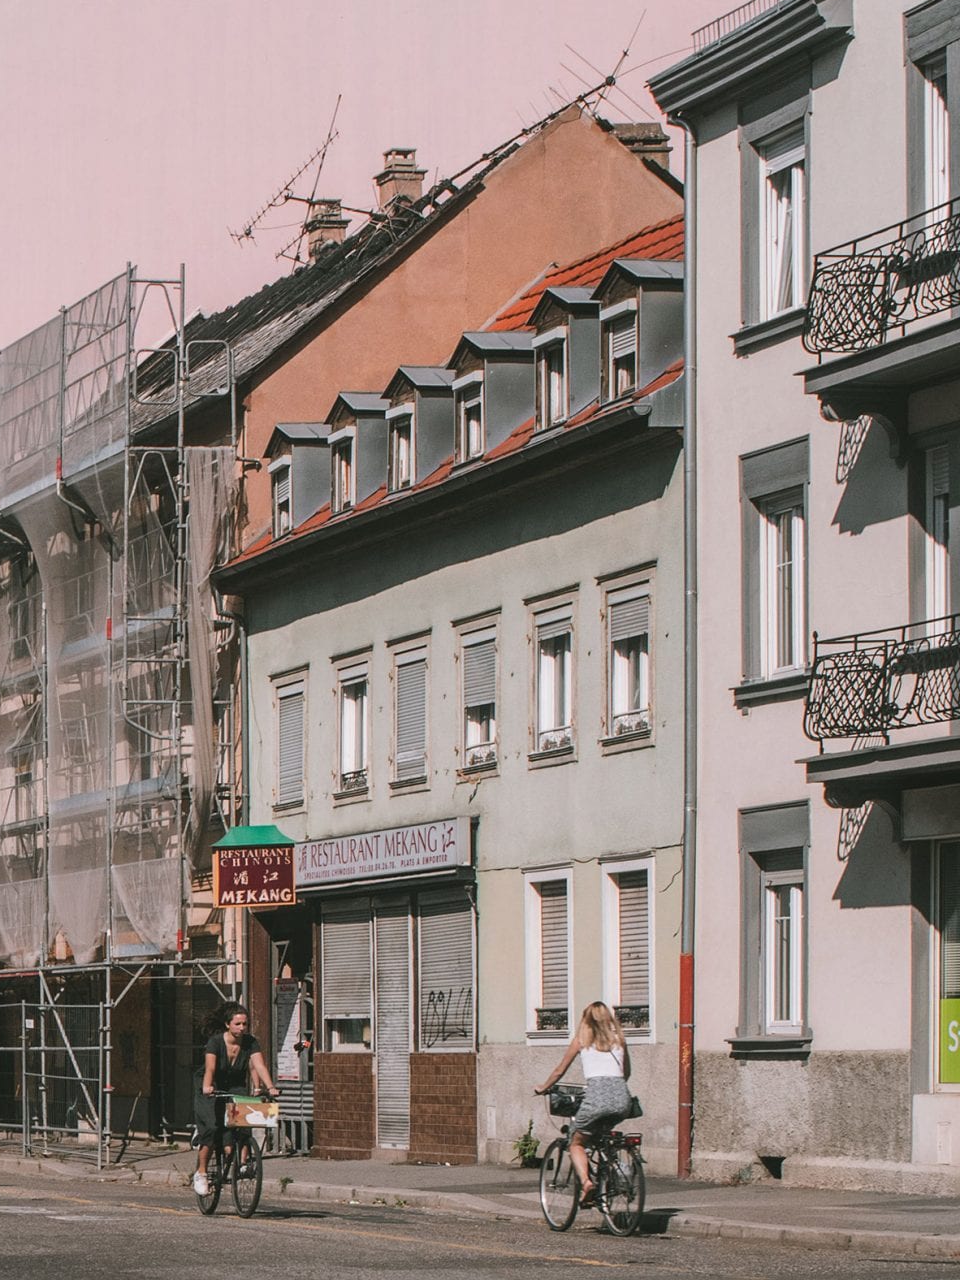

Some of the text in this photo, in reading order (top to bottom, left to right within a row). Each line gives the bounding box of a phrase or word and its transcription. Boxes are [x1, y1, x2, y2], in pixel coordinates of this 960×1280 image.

[220, 847, 291, 859] RESTAURANT
[311, 834, 381, 868] RESTAURANT
[384, 825, 438, 859] MEKANG
[220, 856, 292, 868] CHINOIS
[221, 888, 293, 904] MEKANG
